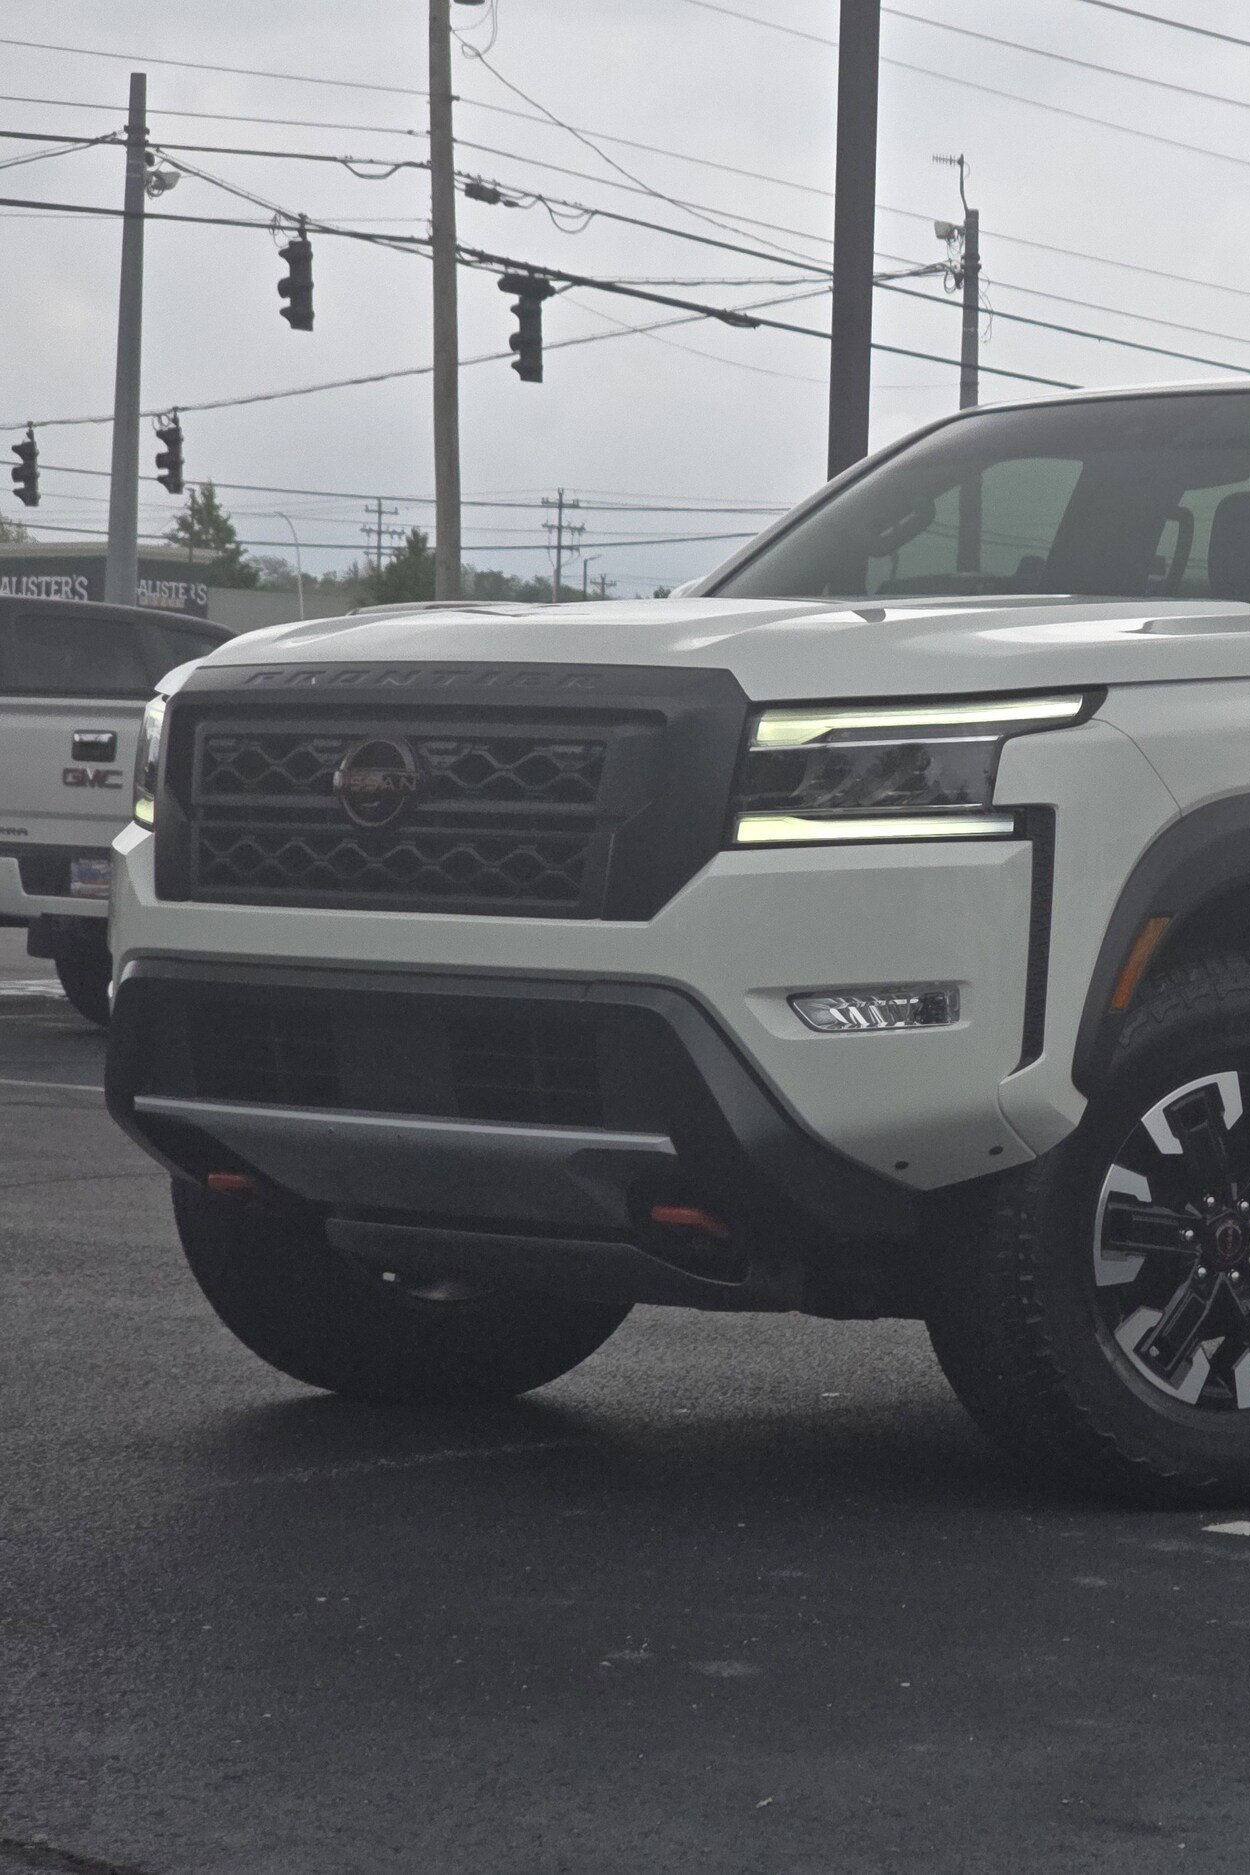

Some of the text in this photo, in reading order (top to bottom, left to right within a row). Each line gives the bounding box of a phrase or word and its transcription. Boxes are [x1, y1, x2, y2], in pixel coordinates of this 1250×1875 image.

[244, 670, 604, 689] FRONTIER
[62, 767, 123, 789] GMC
[341, 774, 418, 792] NISSAN
